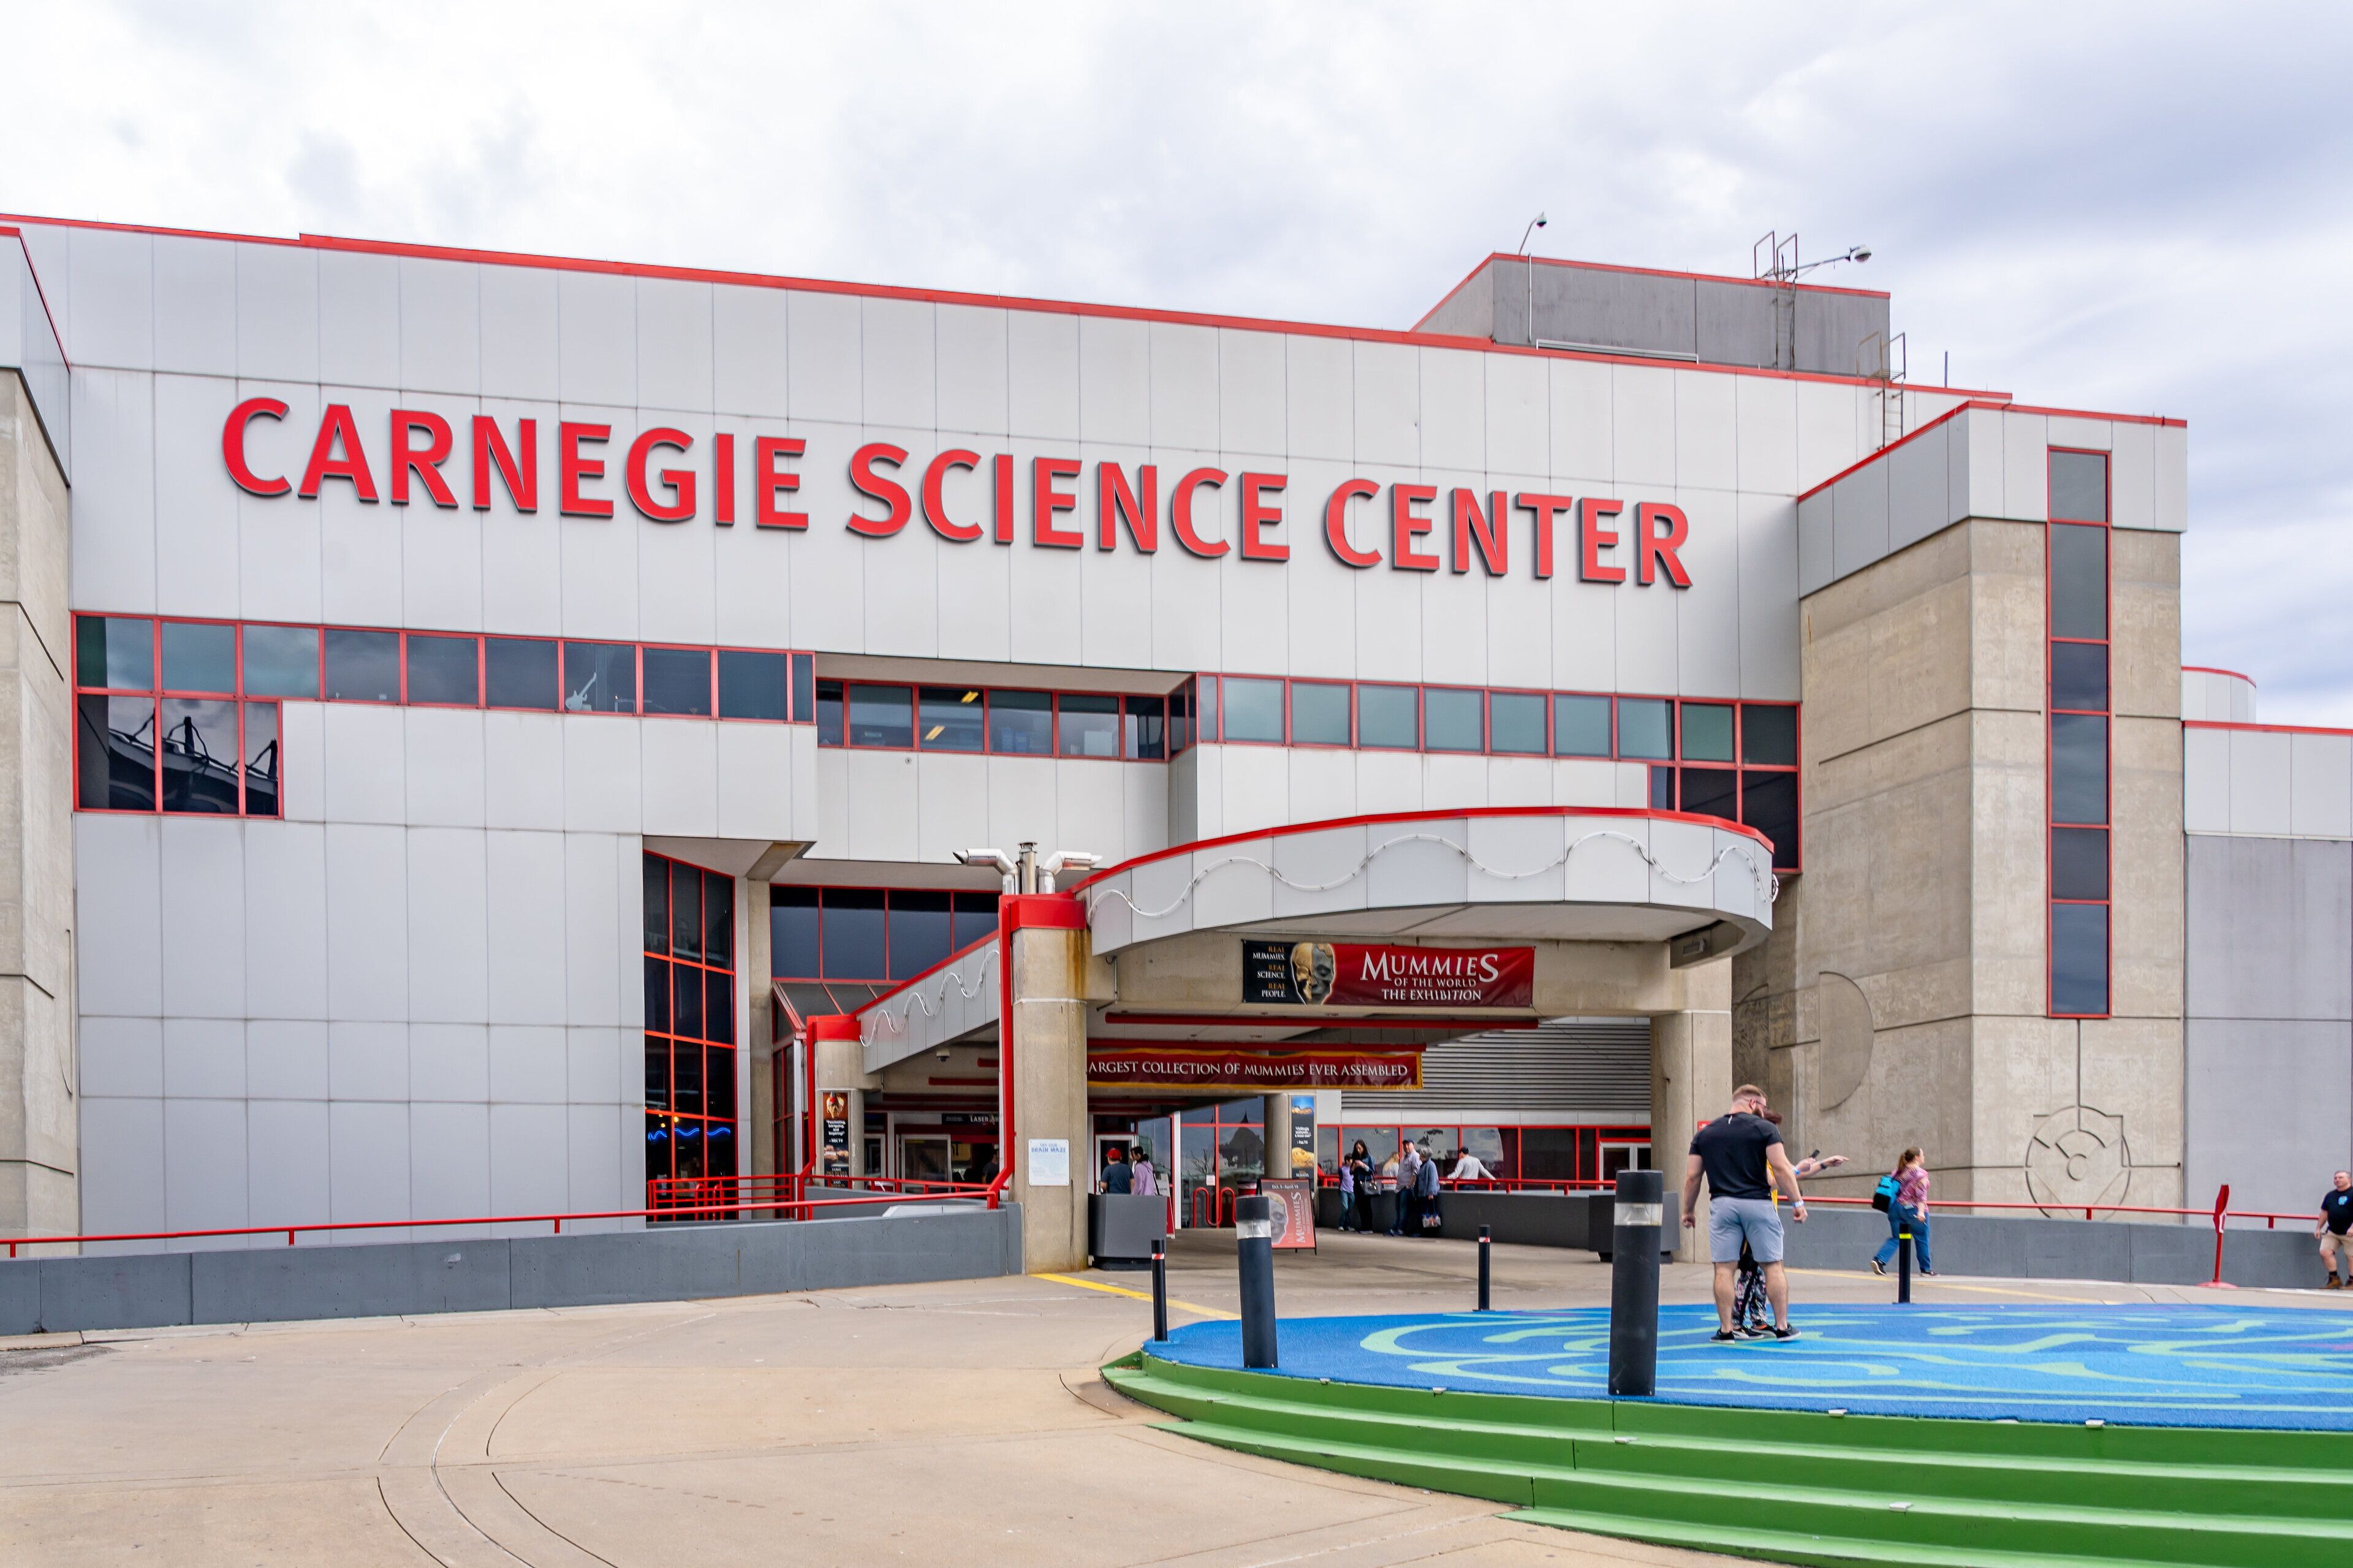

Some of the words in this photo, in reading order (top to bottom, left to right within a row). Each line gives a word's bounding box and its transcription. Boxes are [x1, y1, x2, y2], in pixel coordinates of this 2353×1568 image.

[222, 397, 810, 529] CARNEGIE
[846, 442, 1290, 561] SCIENCE
[1324, 479, 1694, 589] CENTER
[1360, 950, 1499, 983] MUMMIES
[1382, 988, 1406, 1000] THE
[1410, 988, 1481, 1001] EXHIBITION
[1393, 977, 1408, 987] OF
[1412, 977, 1433, 987] THE
[1437, 977, 1477, 988] WORLD
[1088, 1061, 1139, 1074] ARGEST
[1142, 1061, 1221, 1075] COLLECTION
[1225, 1062, 1241, 1075] OF
[1245, 1064, 1305, 1076] MUMMIES
[1309, 1064, 1338, 1077] EVER
[1341, 1064, 1408, 1077] ASSEMBLED
[1291, 1191, 1306, 1244] MUMMIES
